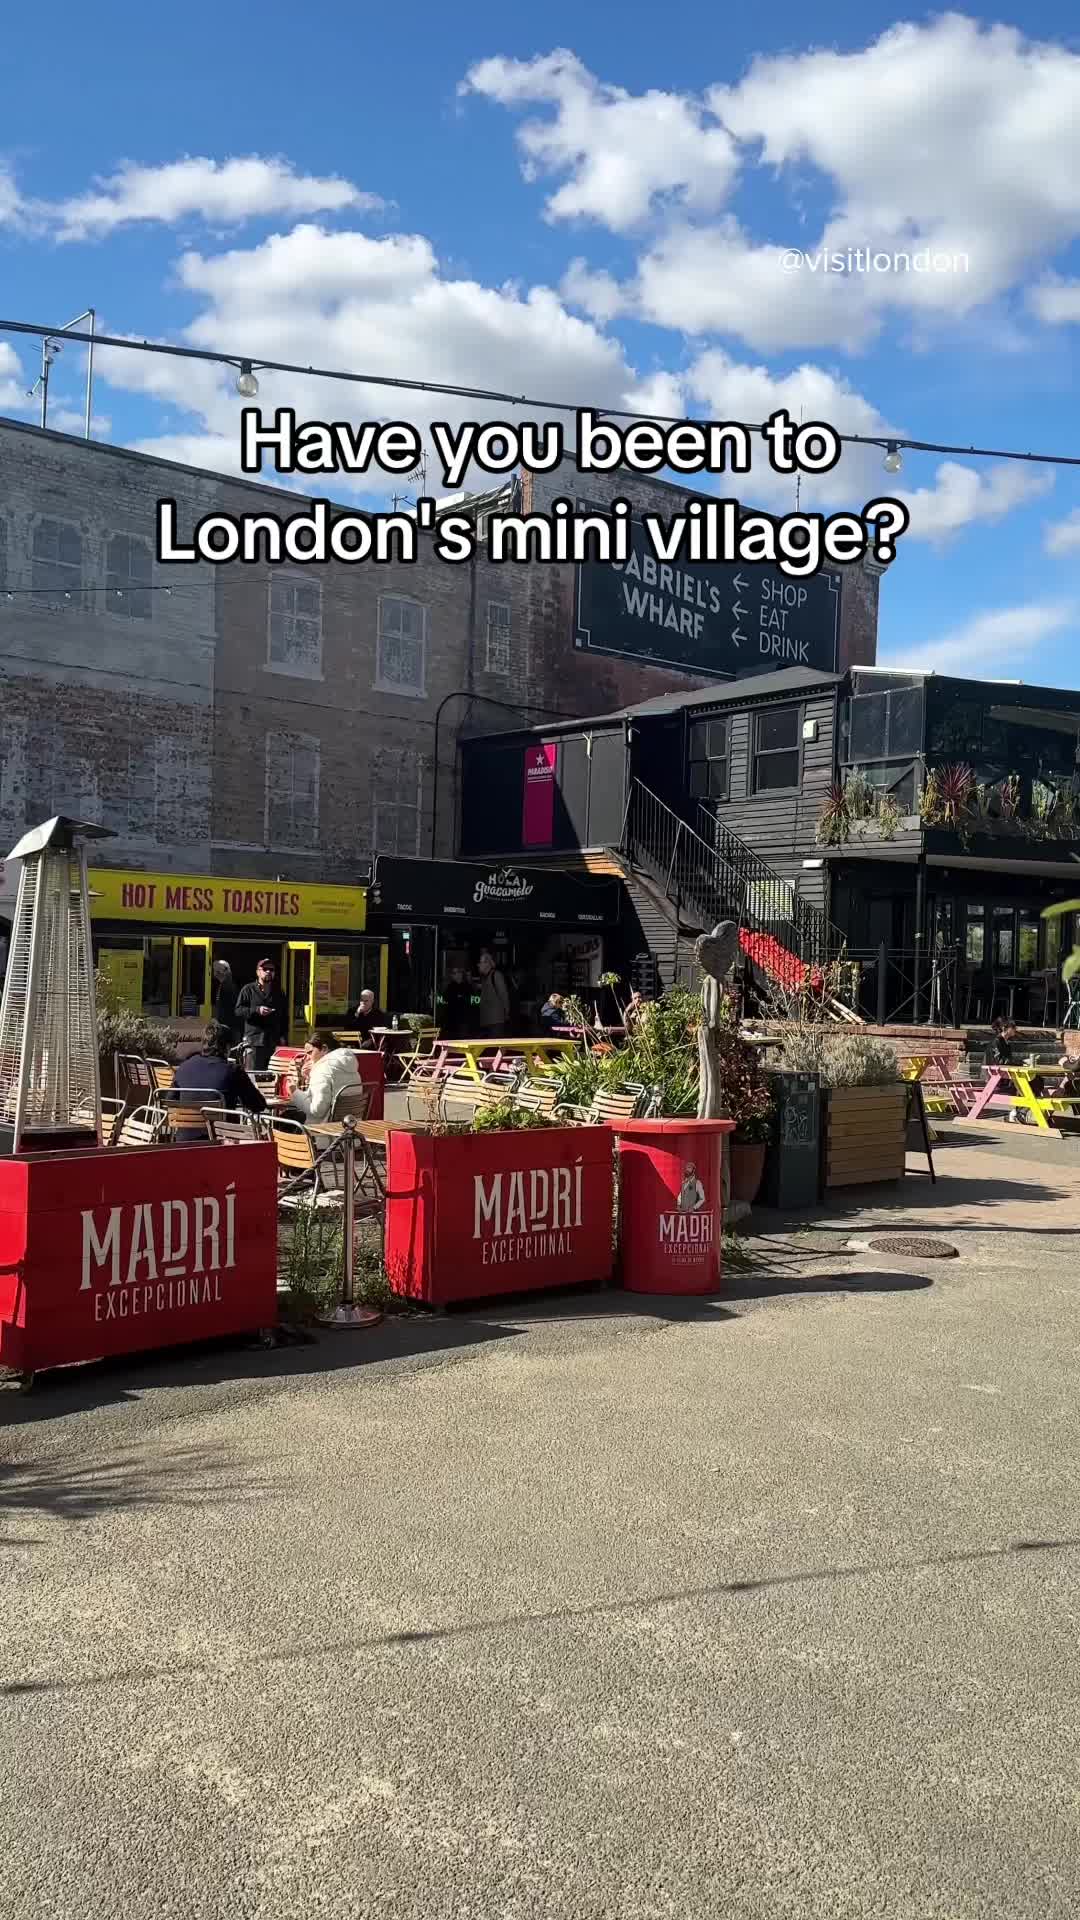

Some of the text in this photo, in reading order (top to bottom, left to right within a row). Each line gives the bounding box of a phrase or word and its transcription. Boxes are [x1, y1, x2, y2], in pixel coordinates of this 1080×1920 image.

[611, 550, 721, 614] ABRIEL'S
[761, 578, 808, 608] SHOP
[622, 581, 705, 640] WHARF
[759, 605, 789, 631] EAT
[759, 631, 809, 663] DRINK
[121, 883, 156, 908] HOT
[165, 885, 213, 912] MESS
[222, 888, 300, 915] TOASTIES
[472, 1155, 583, 1239] MADRÍ
[79, 1181, 237, 1291] MADRÍ
[482, 1231, 573, 1265] EXCEPCIONAL
[664, 1243, 709, 1254] EXCEPCIONAL
[95, 1275, 222, 1321] EXCEPCIONAL
